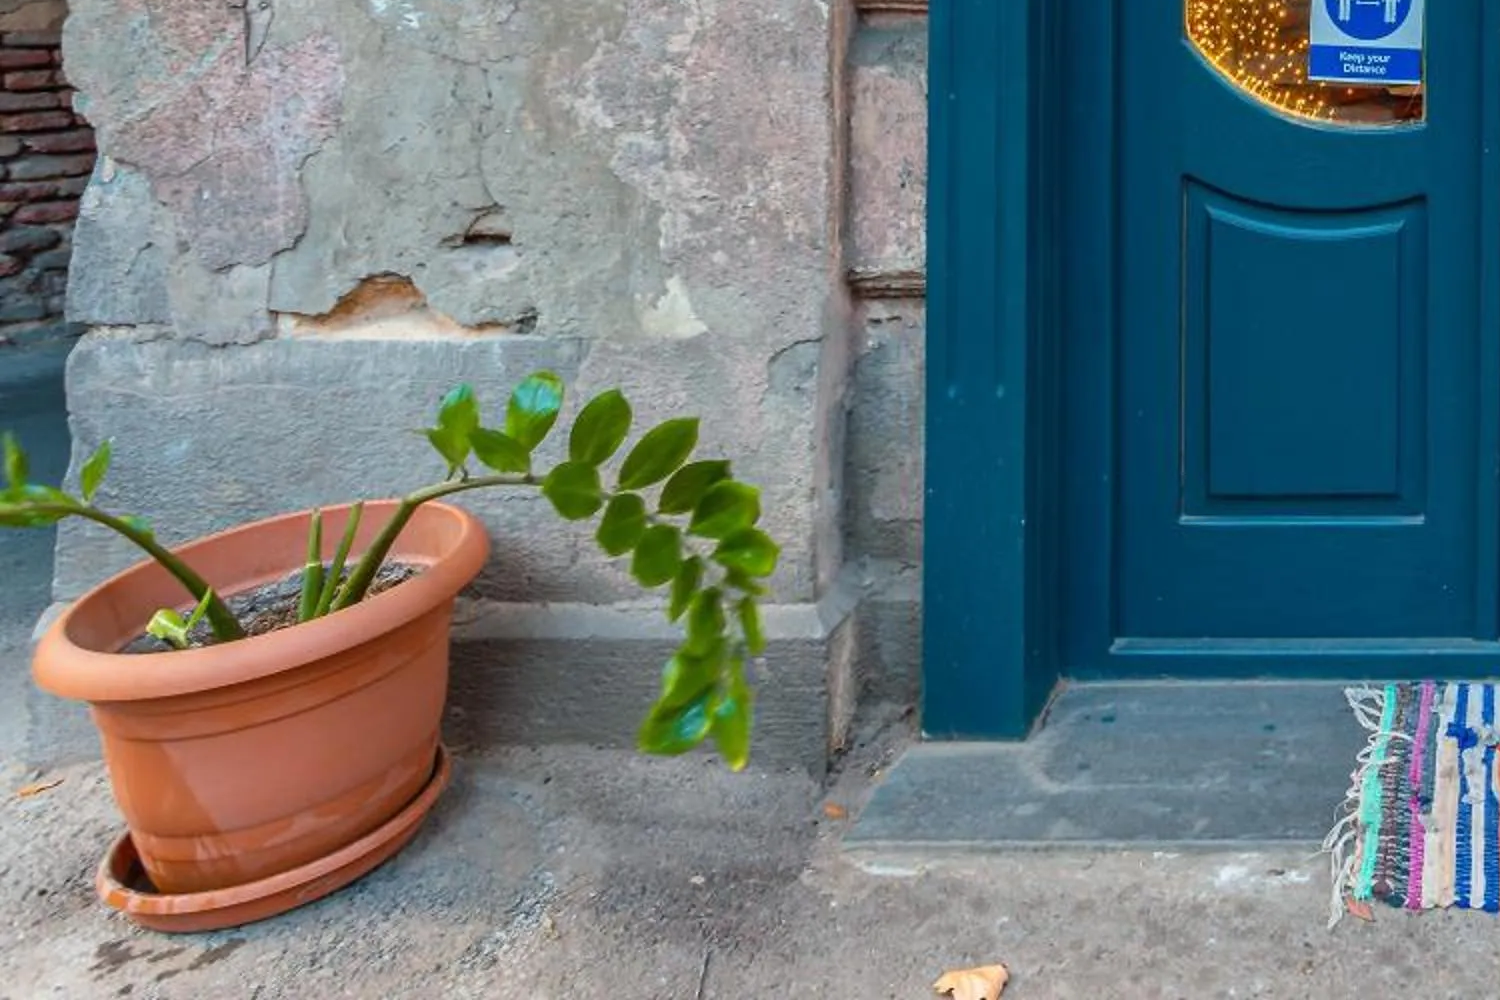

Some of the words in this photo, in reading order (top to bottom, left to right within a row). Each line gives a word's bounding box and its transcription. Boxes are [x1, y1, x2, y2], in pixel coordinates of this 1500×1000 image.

[1340, 51, 1365, 63] Keep
[1367, 54, 1391, 64] your
[1343, 63, 1387, 74] Distance
